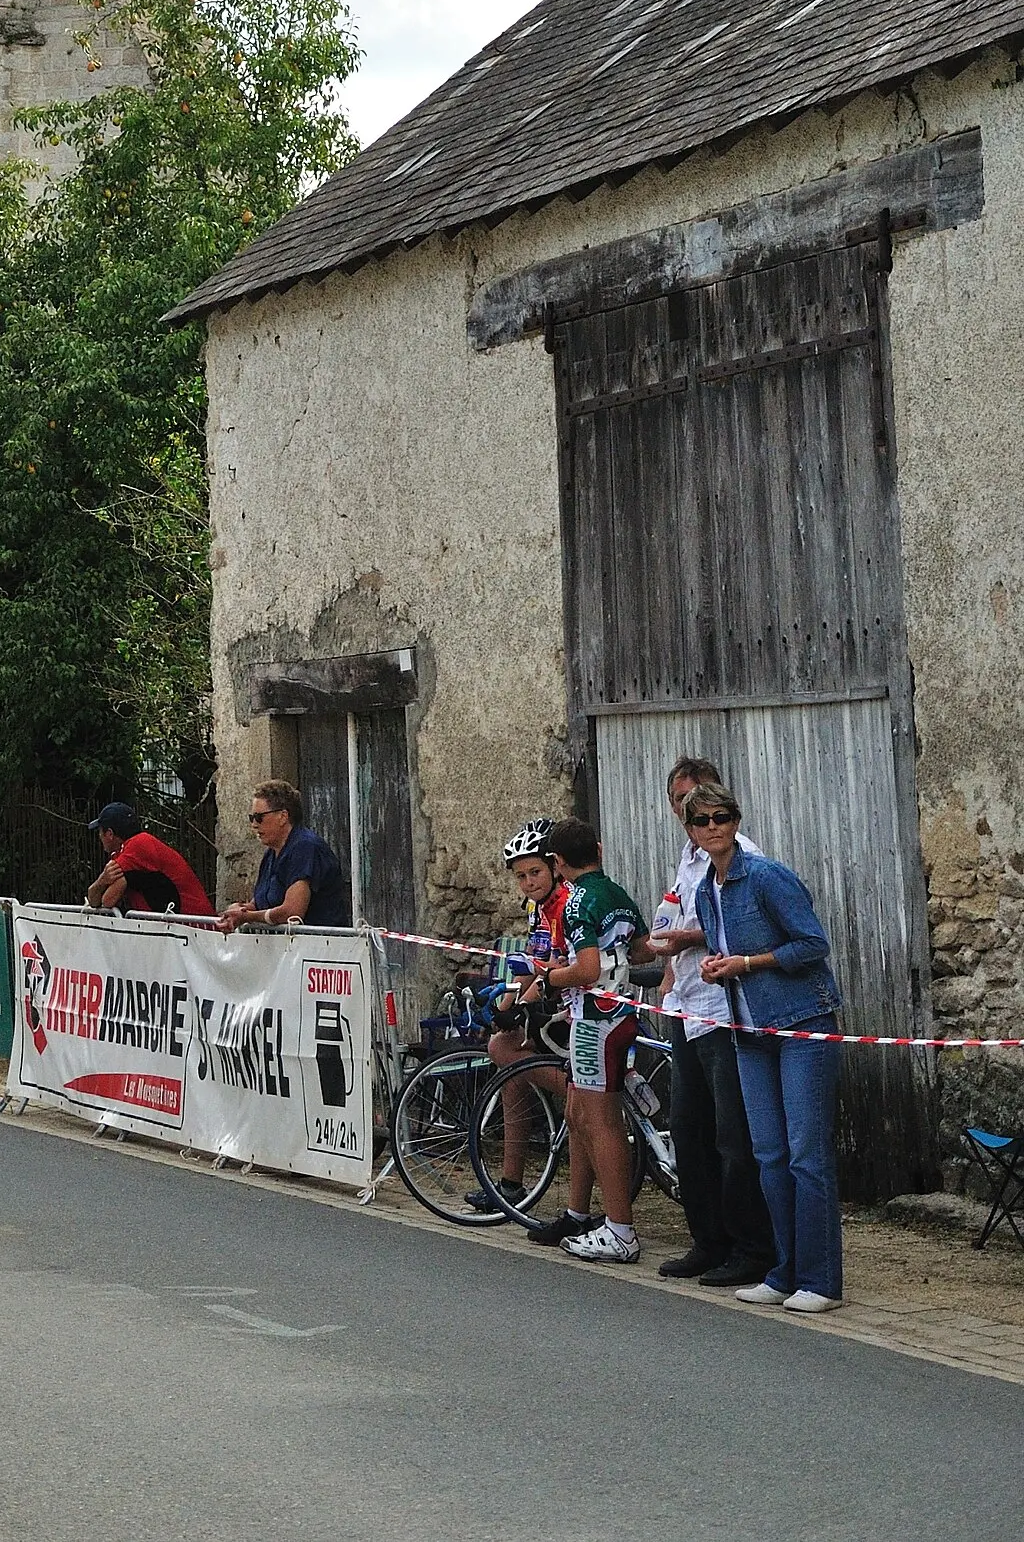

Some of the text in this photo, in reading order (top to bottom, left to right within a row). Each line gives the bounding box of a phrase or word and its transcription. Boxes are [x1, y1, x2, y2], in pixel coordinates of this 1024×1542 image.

[307, 967, 353, 996] STATION
[194, 995, 216, 1082] ST
[575, 1021, 601, 1077] GARNIER
